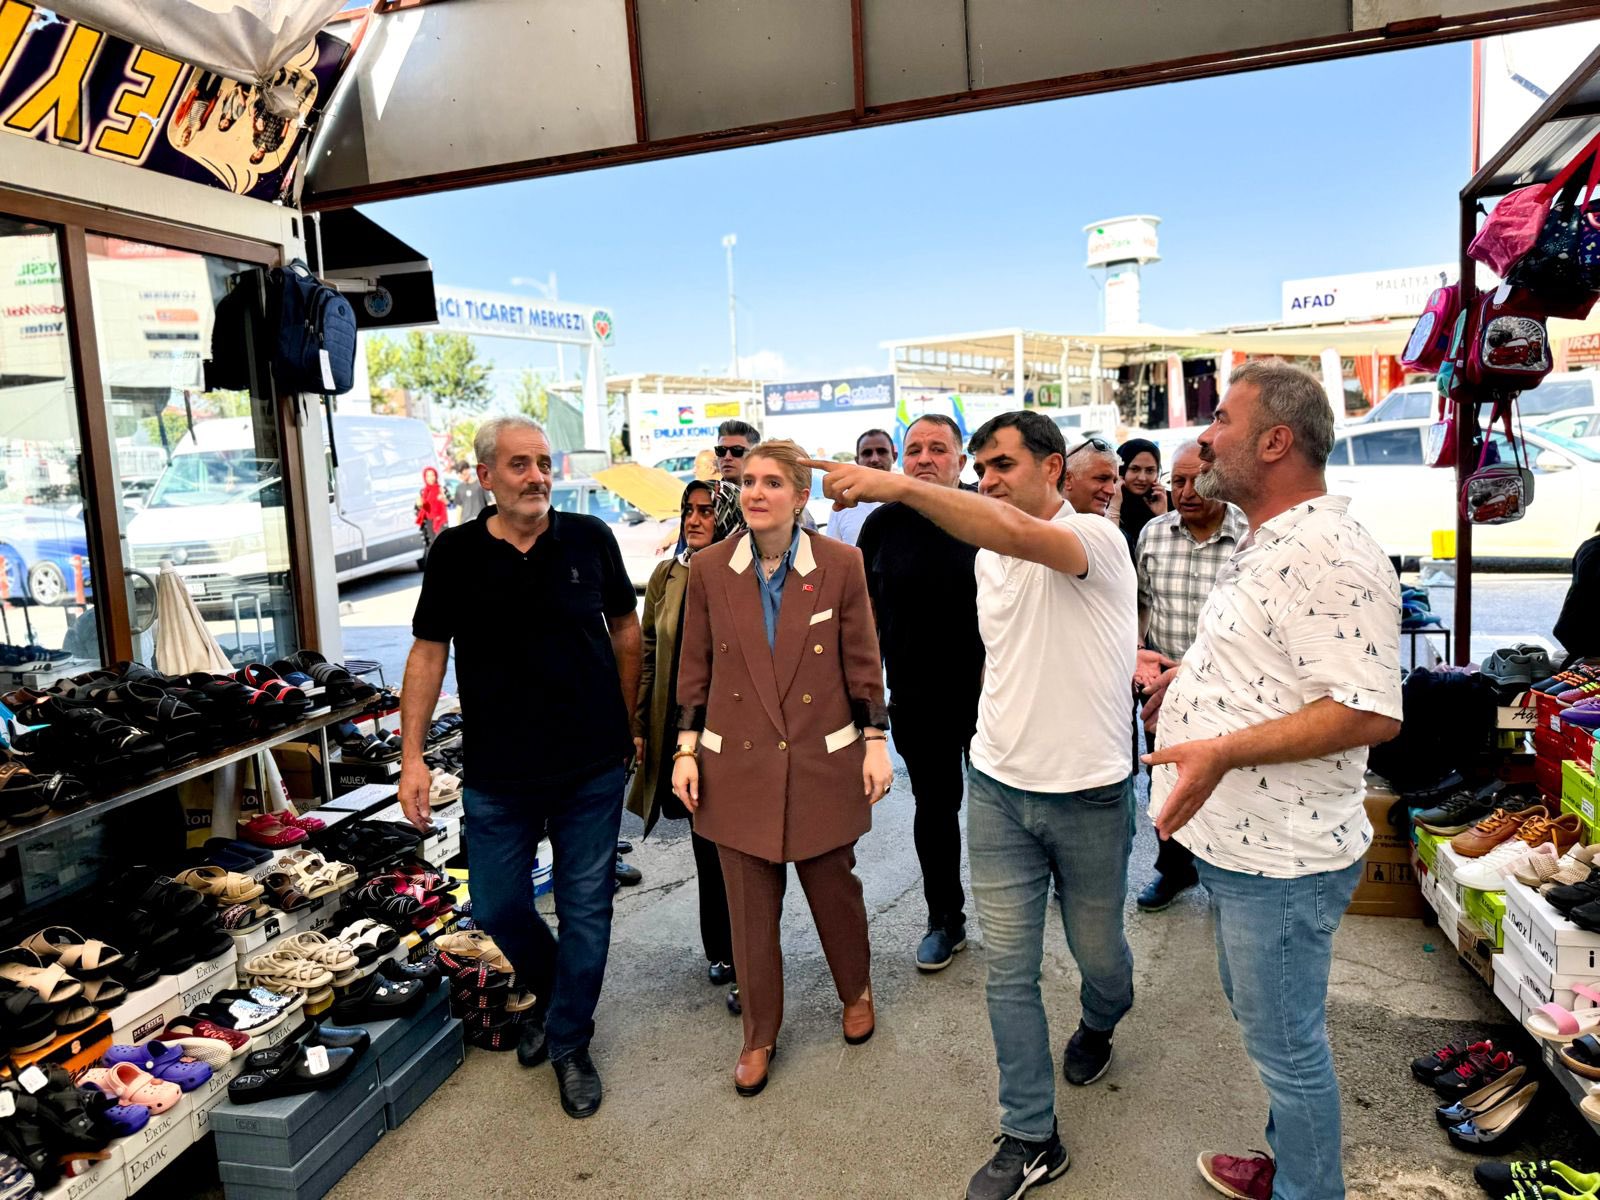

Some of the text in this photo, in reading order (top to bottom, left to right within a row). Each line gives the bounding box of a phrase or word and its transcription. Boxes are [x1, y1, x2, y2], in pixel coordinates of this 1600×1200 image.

[1291, 293, 1335, 310] AFAD
[653, 428, 685, 439] EMLAK
[340, 775, 367, 786] MULEX
